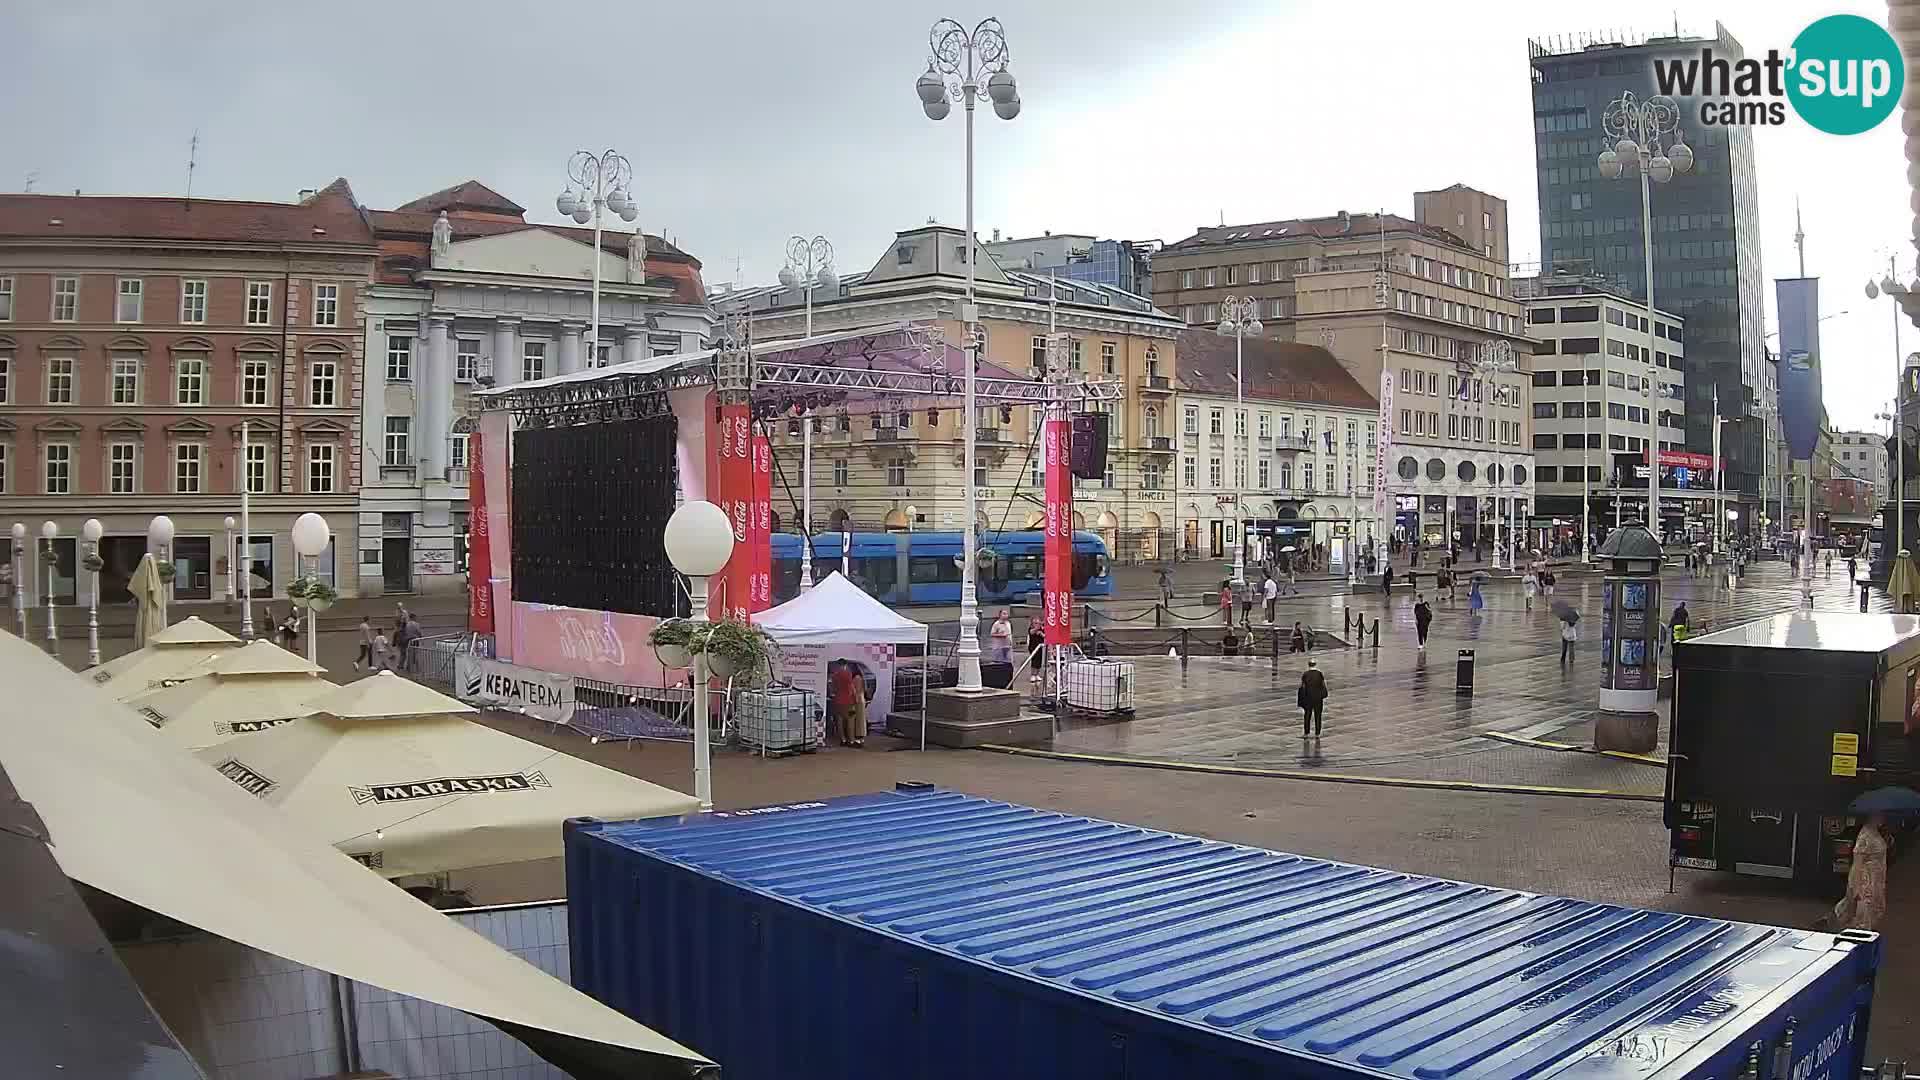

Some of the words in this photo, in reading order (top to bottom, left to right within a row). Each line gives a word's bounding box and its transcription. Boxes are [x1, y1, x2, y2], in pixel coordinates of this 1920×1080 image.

[734, 416, 748, 458] Coca-Cola
[960, 488, 996, 498] SGER
[734, 499, 747, 542] Coca-Cola
[486, 673, 563, 711] KERATERM
[382, 777, 524, 800] MARASKA
